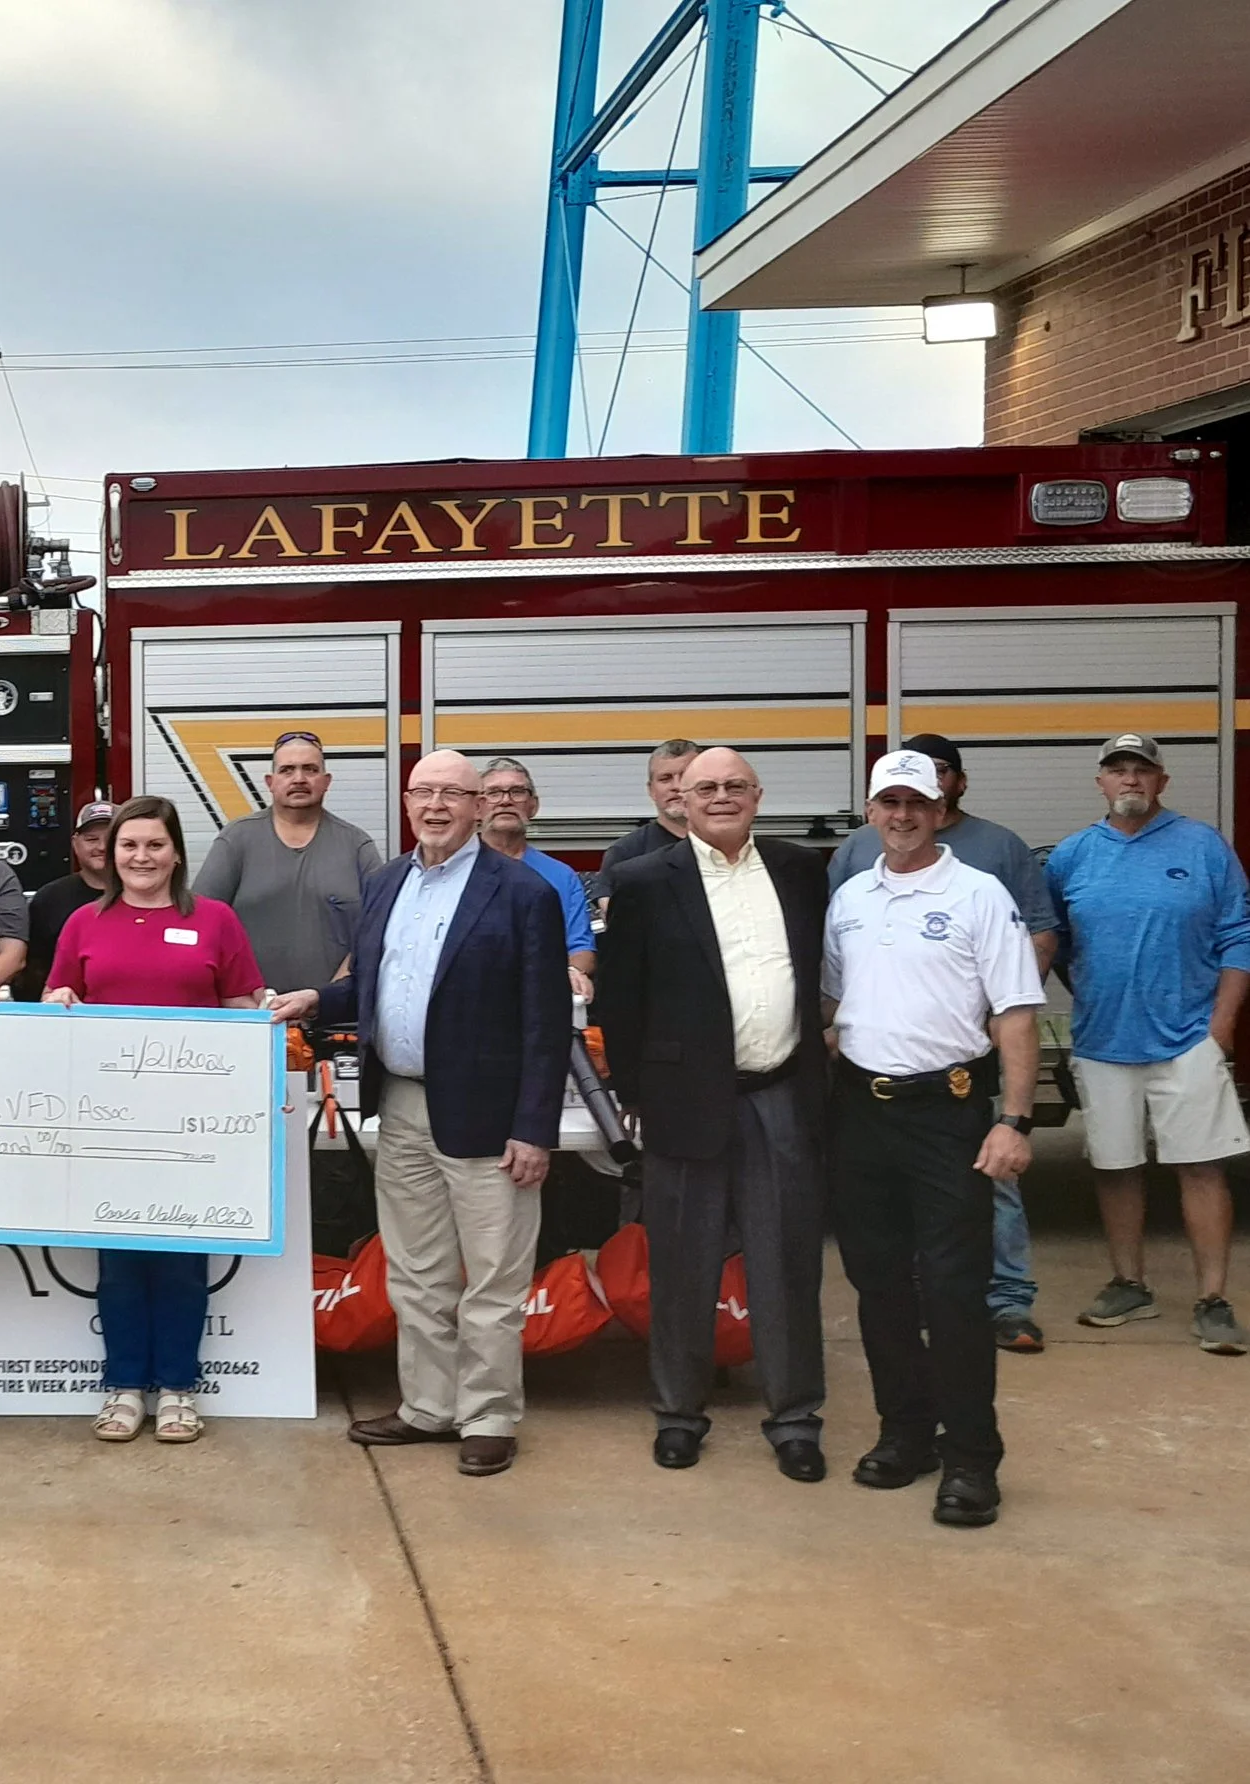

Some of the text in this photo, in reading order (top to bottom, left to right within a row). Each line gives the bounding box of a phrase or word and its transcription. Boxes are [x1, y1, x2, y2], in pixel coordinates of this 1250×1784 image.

[1176, 225, 1250, 343] FI
[163, 487, 802, 562] LAFAYETTE
[121, 1035, 236, 1079] 4/21/2026
[147, 1203, 199, 1229] Valley
[34, 1360, 107, 1375] RESPONDE
[198, 1361, 260, 1375] 202662
[27, 1380, 67, 1394] WEEK
